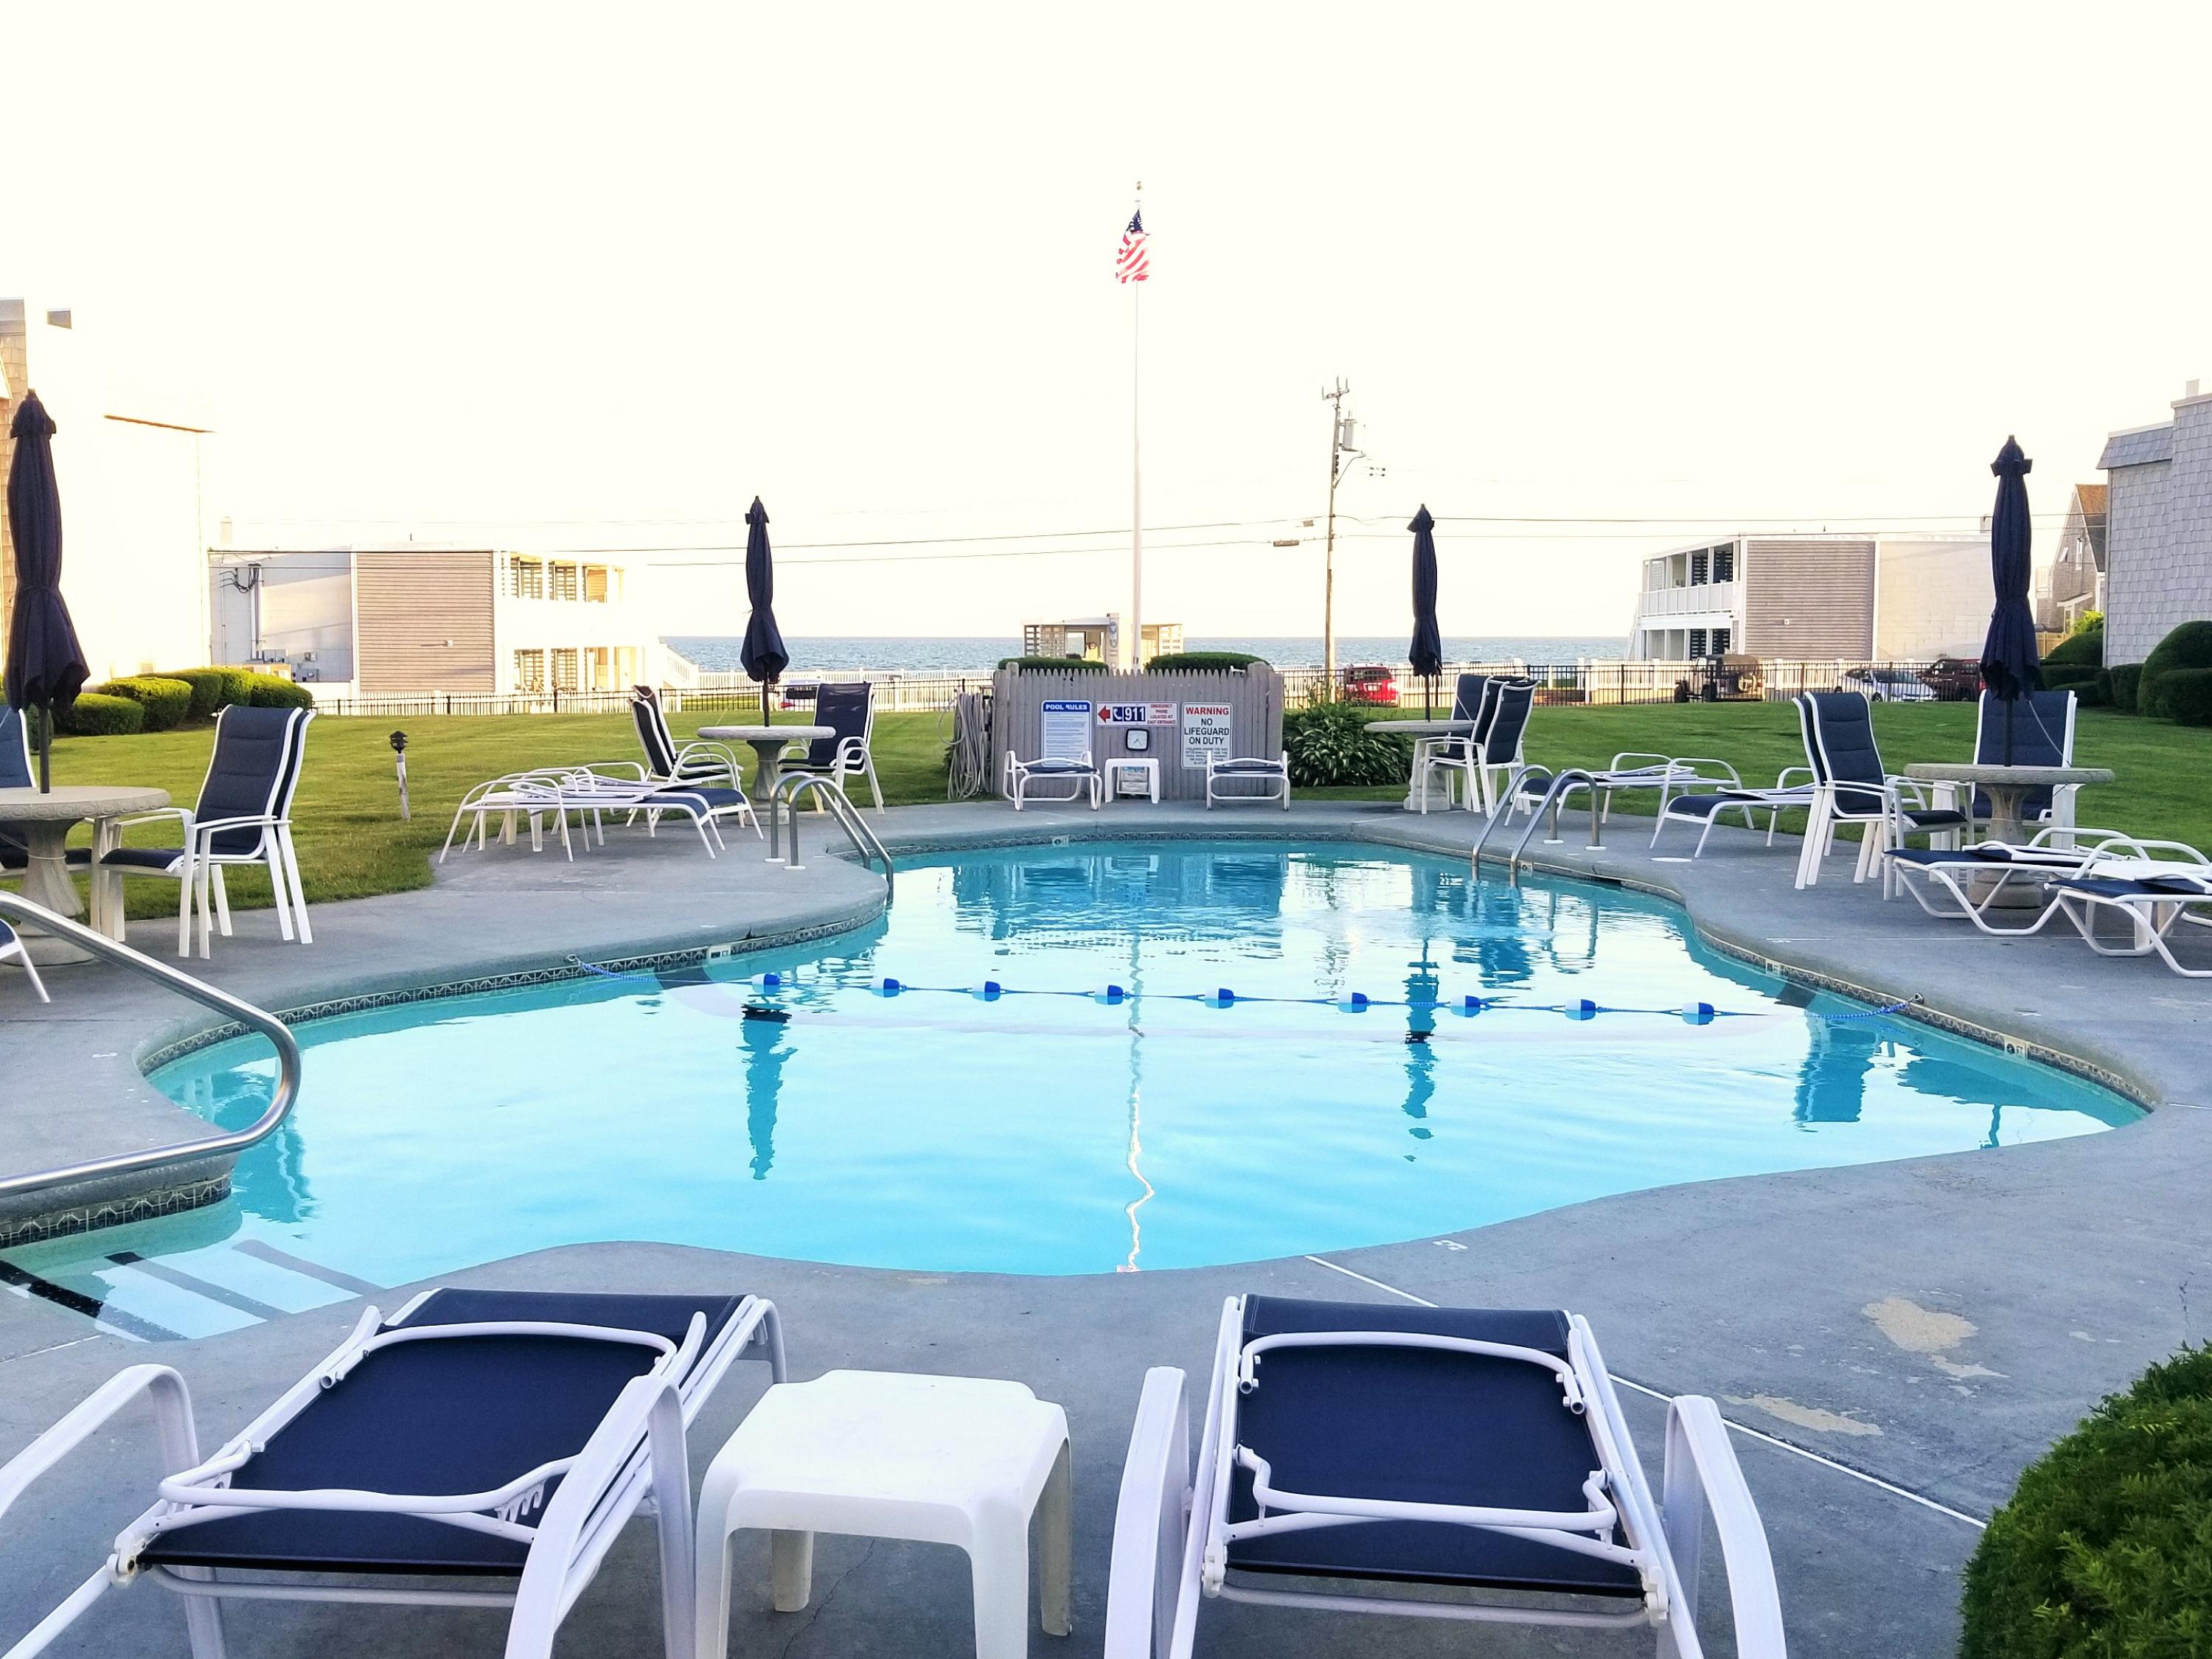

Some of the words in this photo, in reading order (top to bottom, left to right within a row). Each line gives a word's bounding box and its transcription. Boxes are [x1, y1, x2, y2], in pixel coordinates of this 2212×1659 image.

[1124, 707, 1144, 721] 911
[1186, 706, 1229, 715] WARNING
[1200, 717, 1213, 726] NO
[1183, 727, 1230, 736] LIFEGUARD
[1189, 737, 1201, 745] ON
[1203, 737, 1225, 745] DUTY
